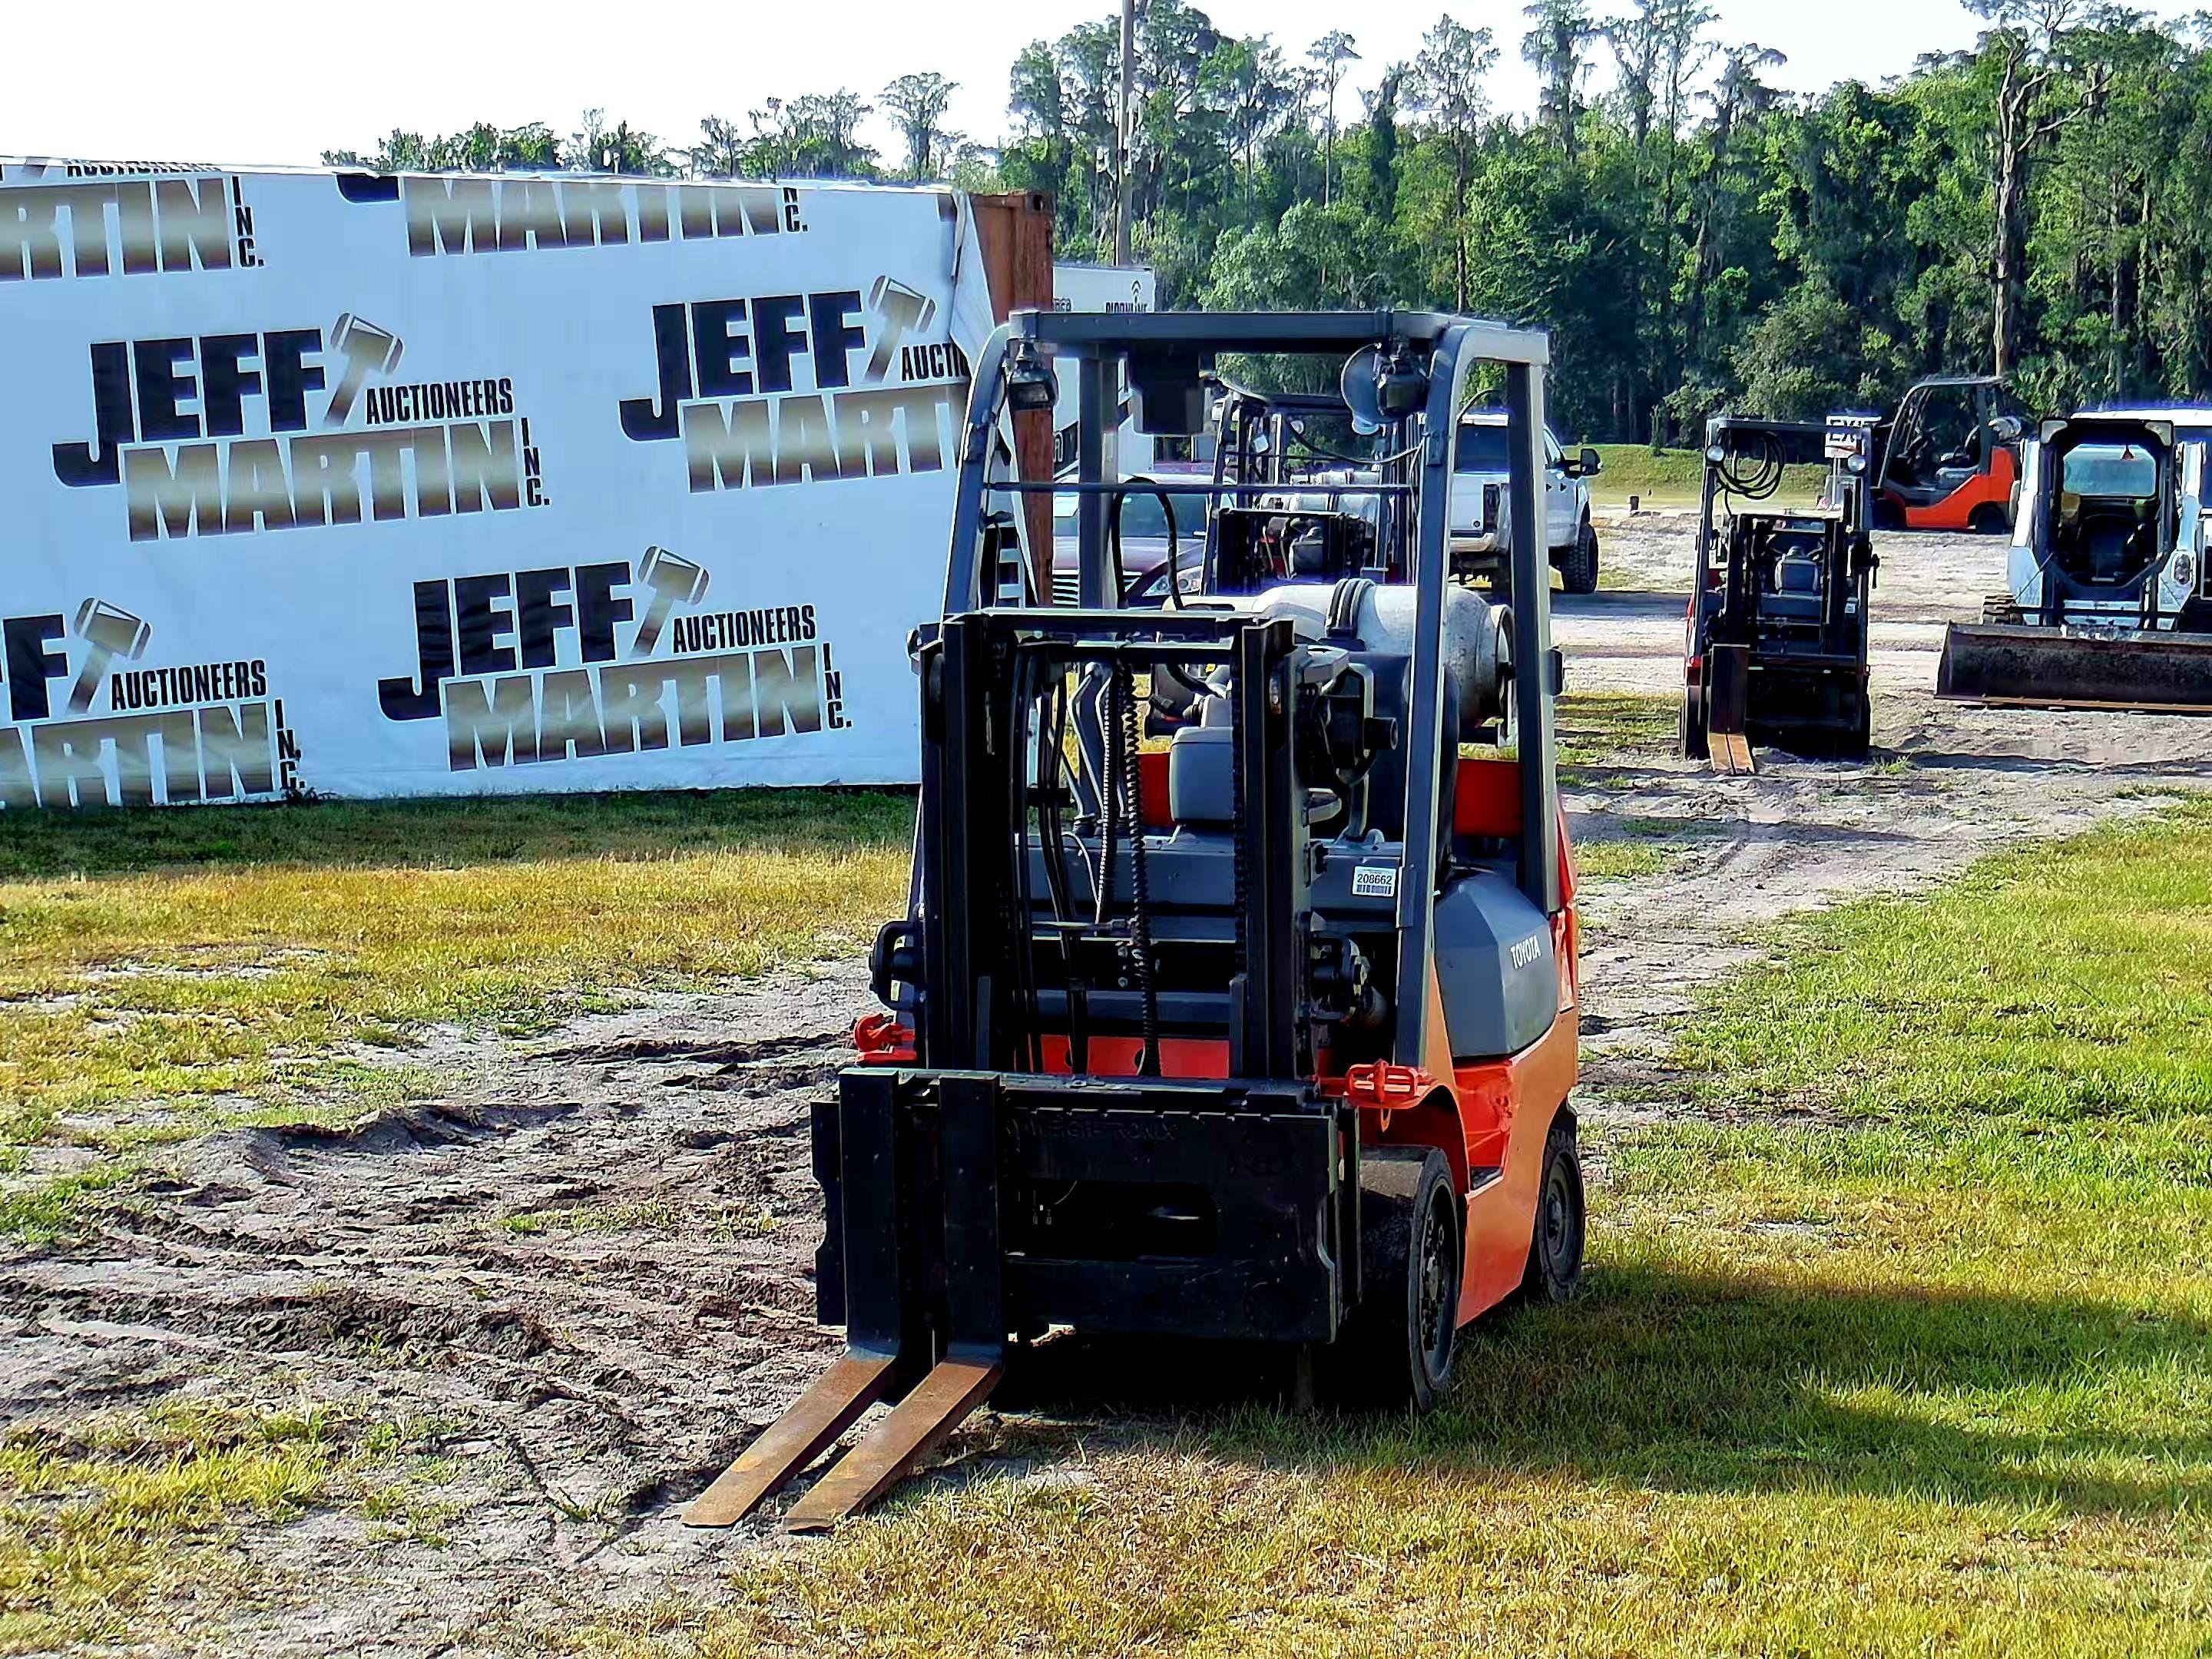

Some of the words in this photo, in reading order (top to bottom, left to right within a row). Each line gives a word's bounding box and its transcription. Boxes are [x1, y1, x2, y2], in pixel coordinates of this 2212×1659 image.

[51, 329, 326, 487] JEFF
[366, 377, 514, 426] AUCTIONEERS
[618, 290, 865, 441] JEFF
[123, 420, 520, 542] MARTIN
[521, 417, 550, 507] INC.
[378, 562, 633, 720] JEFF
[673, 604, 816, 654] AUCTIONEERS
[112, 660, 267, 710] AUCTIONEERS
[445, 646, 821, 771] MARTIN
[823, 643, 853, 730] INC.
[1357, 873, 1392, 885] 208662
[1510, 935, 1541, 969] TOYOTA
